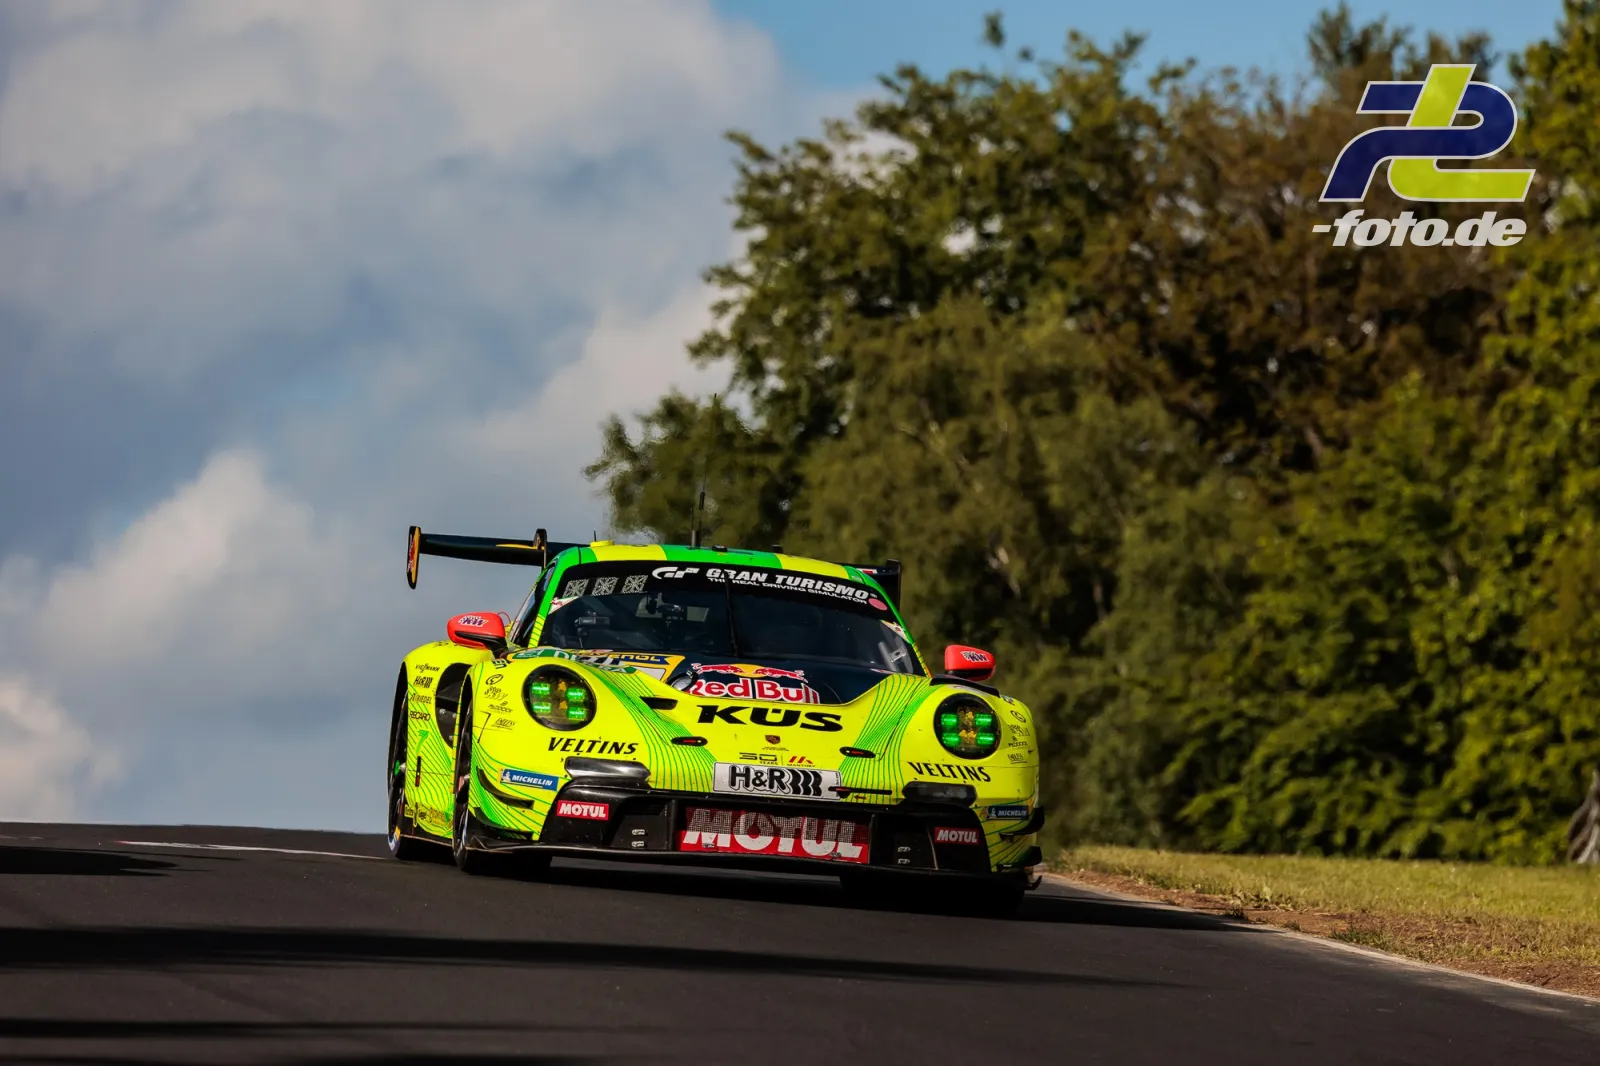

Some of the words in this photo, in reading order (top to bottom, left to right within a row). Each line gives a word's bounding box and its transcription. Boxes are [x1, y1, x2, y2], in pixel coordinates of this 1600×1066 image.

[706, 568, 766, 584] GRAN
[775, 574, 869, 600] TURISMO
[732, 579, 760, 587] REAL
[762, 582, 807, 593] DRIVING
[807, 588, 868, 605] SIMULATOR
[754, 679, 820, 705] Bull
[697, 704, 843, 732] KÜS
[547, 737, 638, 755] VELTINS
[511, 774, 553, 787] MICHELIN
[729, 765, 788, 793] H&R
[907, 762, 991, 783] VELTINS
[558, 803, 606, 818] MOTUL
[997, 809, 1028, 817] MICHELIN
[682, 808, 863, 858] MOTUL
[936, 829, 978, 843] MOTUL
